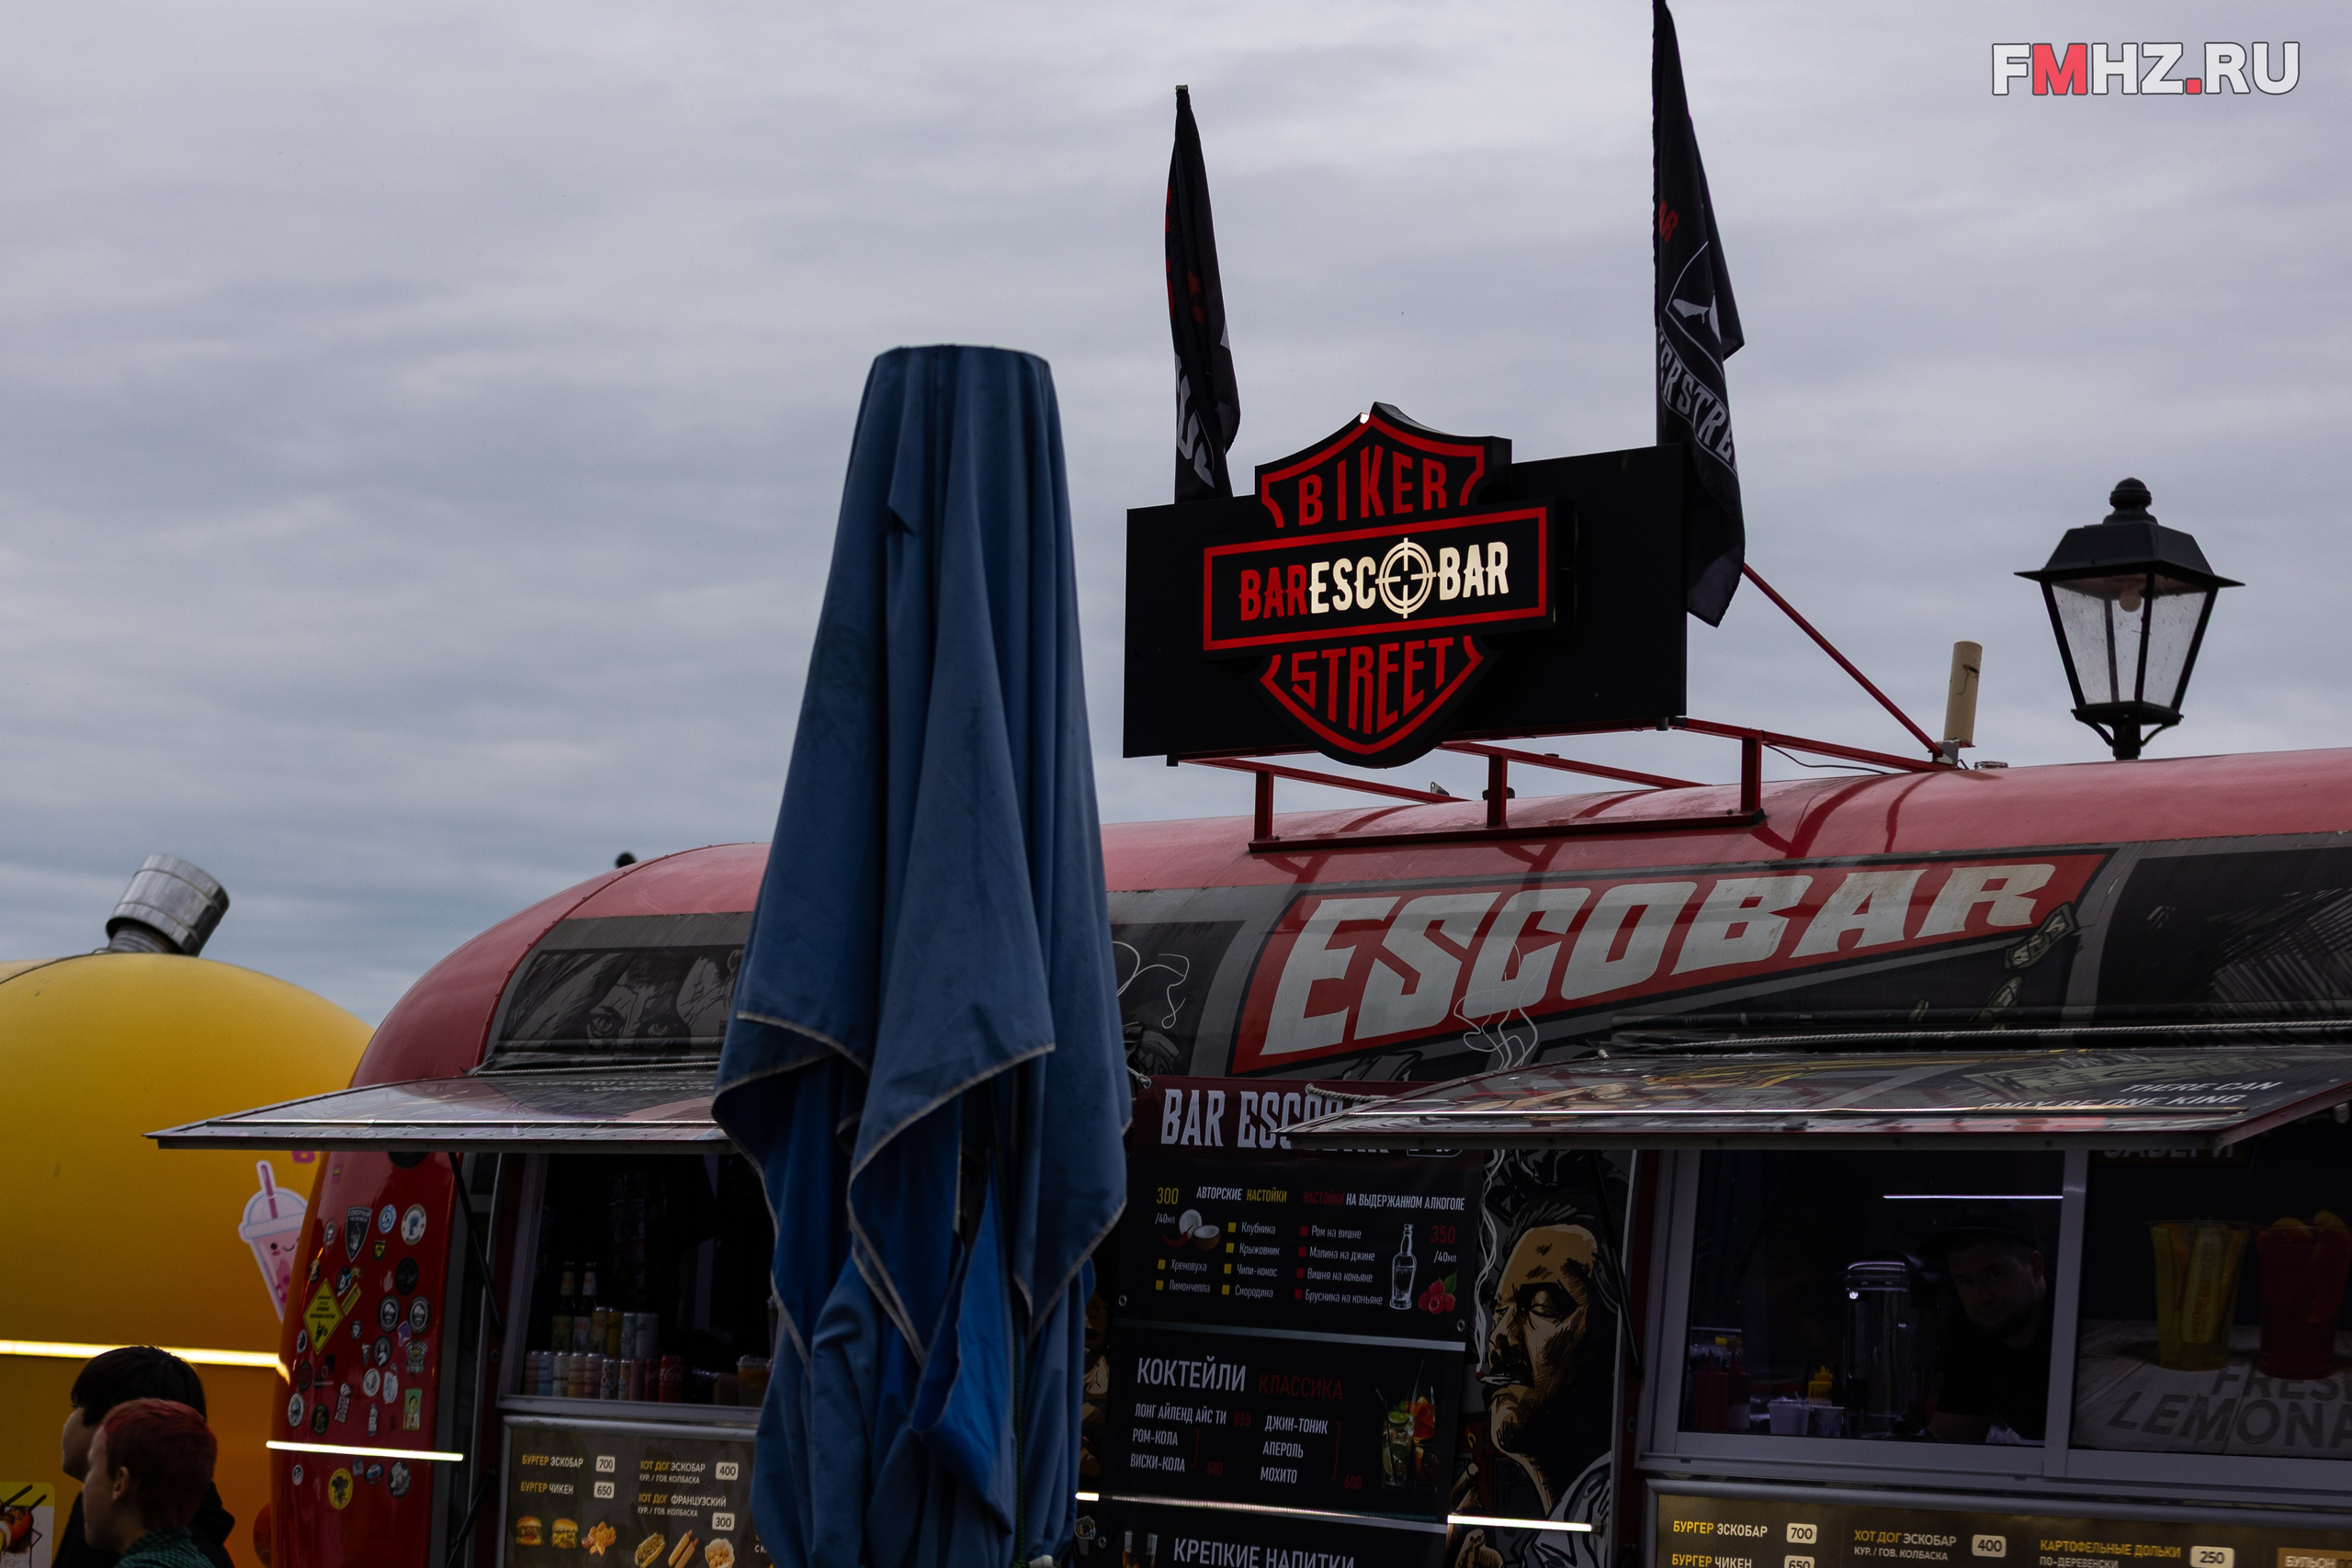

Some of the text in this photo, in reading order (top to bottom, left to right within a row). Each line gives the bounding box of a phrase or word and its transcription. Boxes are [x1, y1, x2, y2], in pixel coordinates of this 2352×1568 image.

[1298, 444, 1447, 527] BIKER
[1291, 637, 1454, 735] STREET
[1260, 863, 2055, 1055] ESCOBAR
[2120, 1081, 2284, 1092] THERE CAN
[2165, 1094, 2247, 1105] KING
[1160, 1089, 1226, 1147] BAR
[1157, 1187, 1179, 1205] 300
[1196, 1186, 1287, 1203] АВТОРСКИЕ НАСТОЙКИ
[1302, 1189, 1465, 1211] НАСТОЙКИ НА ВЫДЕРЖАННОМ АЛКОГОЛЕ
[1241, 1222, 1276, 1236] Клубника
[1311, 1224, 1362, 1239] Ром на вишне
[1430, 1224, 1456, 1244] 350
[1239, 1243, 1280, 1257] Крыжовник
[1309, 1246, 1375, 1262] Малина на джине
[1170, 1258, 1207, 1273] Хреновуха
[1237, 1264, 1278, 1277] Чили-кокос
[1307, 1267, 1374, 1283] Вишня на коньяке
[1235, 1284, 1273, 1299] Смородина
[1305, 1288, 1383, 1305] Брусника на коньяке
[1136, 1355, 1344, 1401] КОКТЕЙЛИ КЛАССИКА
[2211, 1365, 2352, 1402] FRES
[1135, 1402, 1252, 1427] ЛОНГ АЙЛЕНД АЙС ТИ 850
[1264, 1415, 1329, 1435] ДЖИН-ТОНИК
[1132, 1427, 1179, 1446] РОМ-КОЛА
[1262, 1440, 1305, 1459] АПЕРОЛЬ
[521, 1454, 584, 1468] БУРГЕР ЭСКОБАР
[599, 1460, 614, 1470] 700
[639, 1461, 706, 1473] ХОТ ДОГ ЭСКОБАР
[1130, 1453, 1185, 1472] ВИСКИ-КОЛА
[1206, 1460, 1224, 1476] 600
[719, 1466, 737, 1476] 400
[1260, 1466, 1298, 1484] МОХИТО
[669, 1475, 700, 1484] КОЛБАСКА
[1343, 1474, 1363, 1491] 600
[520, 1481, 574, 1495] БУРГЕР ЧИКЕН
[597, 1485, 612, 1495] 650
[638, 1493, 727, 1507] ХОТ ДОГ ФРАНЦУЗСКИЙ
[667, 1507, 698, 1517] КОЛБАСКА
[716, 1517, 731, 1528] 300
[1673, 1520, 1768, 1538] БУРГЕР ЭСКОБАР
[1792, 1528, 1813, 1540] 700
[1854, 1529, 1957, 1547] ХОТ ДОГ ЭСКОБАР
[1173, 1538, 1261, 1567] КРЕПКИЕ
[1854, 1546, 1872, 1556] КУР.
[1878, 1548, 1898, 1558] ГОВ.
[1899, 1550, 1949, 1562] КОЛБАСКА
[1977, 1540, 2002, 1552] 400
[2040, 1539, 2182, 1558] КАРТОФЕЛЬНЫЕ ДОЛЬКИ
[1671, 1553, 1752, 1568] БУРГЕР ЧИКЕН
[2039, 1556, 2119, 1568] ПО-ДЕРЕВЕНСКИ
[2199, 1551, 2225, 1564] 250
